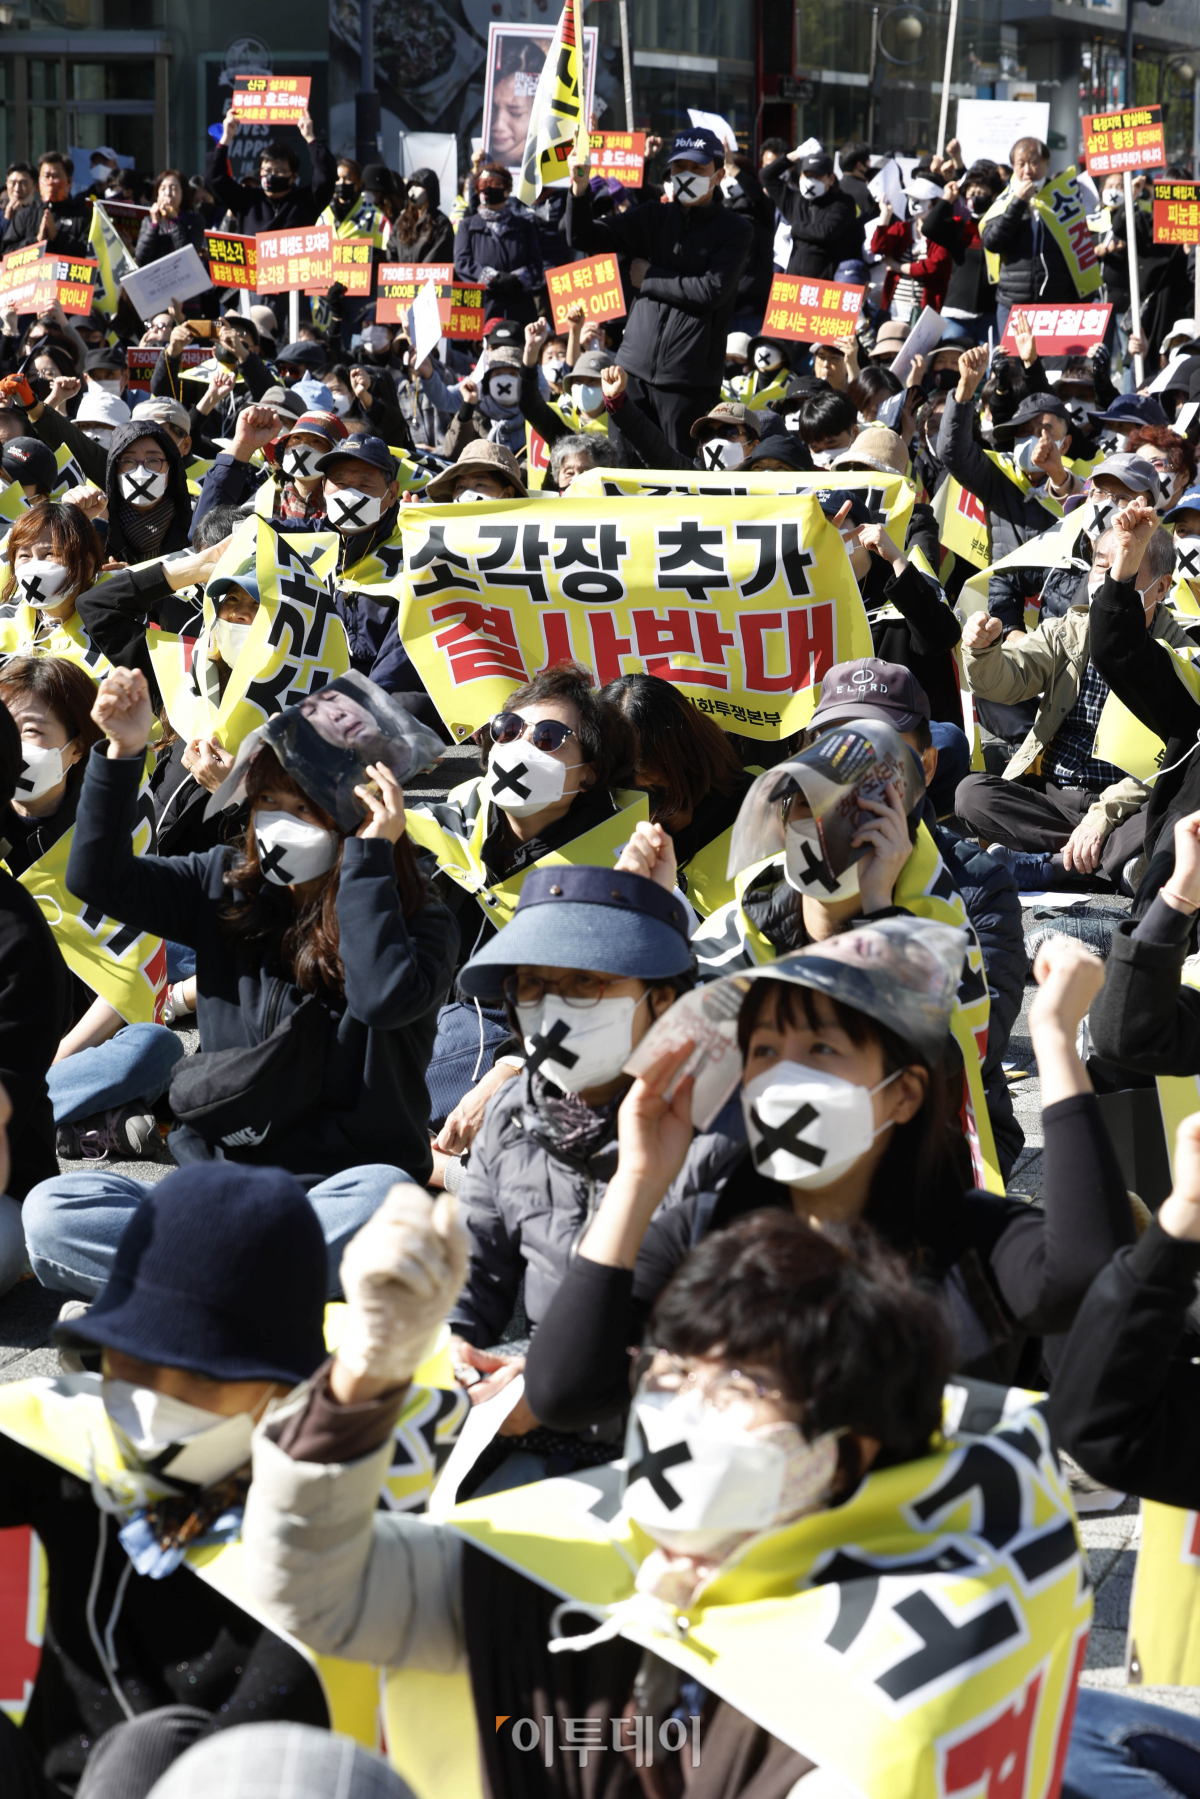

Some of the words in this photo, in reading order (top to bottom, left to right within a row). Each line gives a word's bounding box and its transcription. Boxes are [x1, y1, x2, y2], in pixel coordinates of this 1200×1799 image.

[247, 79, 267, 91] 신규
[675, 138, 706, 149] Volvik
[1087, 134, 1109, 154] 살인
[1112, 130, 1134, 150] 행정
[1155, 185, 1171, 199] 15년
[208, 238, 245, 265] 독박소각
[260, 238, 278, 258] 17년
[304, 231, 330, 254] 모자라
[213, 264, 232, 283] 불공정
[257, 264, 285, 286] 소각장
[415, 267, 449, 281] 모자라서
[551, 272, 572, 296] 독재
[572, 266, 593, 289] 독단
[594, 259, 615, 284] 불통
[384, 284, 415, 299] 1,000톤
[590, 288, 621, 314] OUT!
[821, 288, 842, 310] 불법
[842, 291, 862, 313] 행정
[767, 309, 807, 333] 서울시는
[809, 315, 854, 338] 각성하라!
[409, 524, 627, 603] 소각장
[657, 521, 816, 601] 추가
[430, 601, 837, 694] 결사반대
[836, 683, 888, 694] ELORD
[221, 1126, 257, 1146] NIKE
